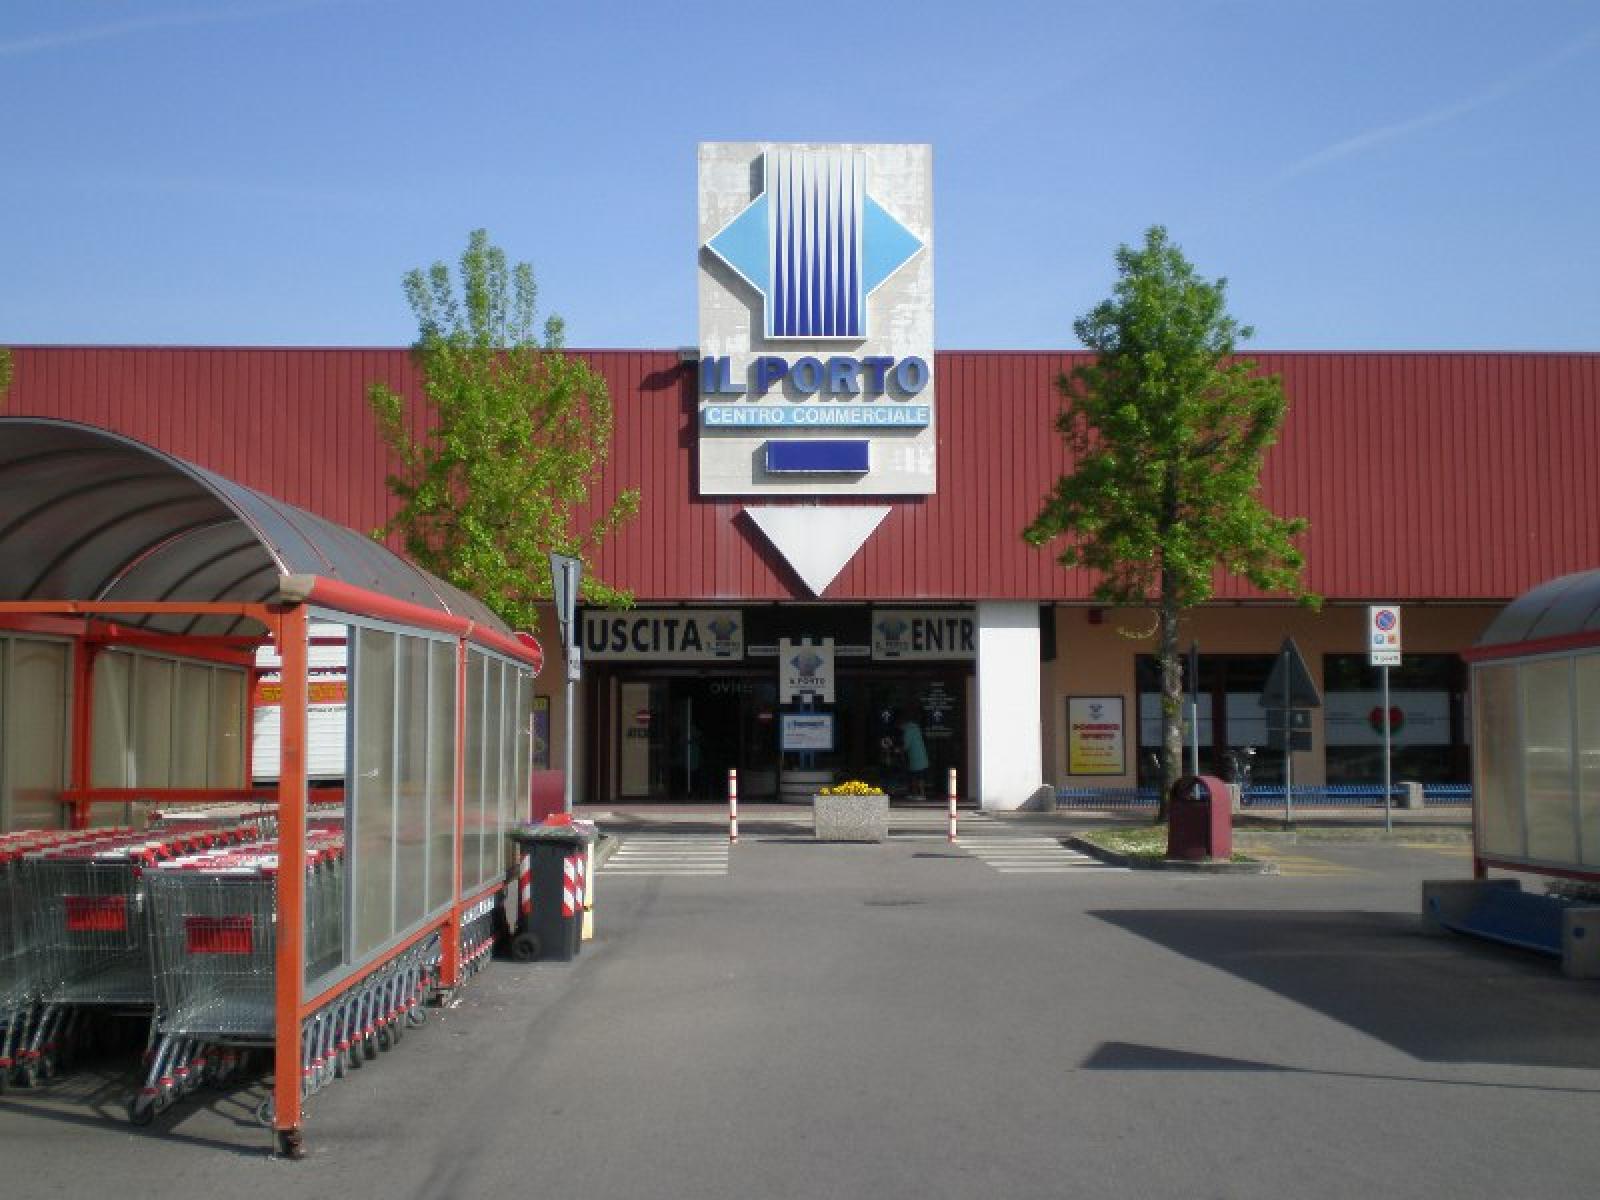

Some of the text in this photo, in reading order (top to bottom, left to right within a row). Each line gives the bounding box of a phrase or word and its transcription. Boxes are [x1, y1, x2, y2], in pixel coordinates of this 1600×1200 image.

[702, 355, 930, 395] IL PORTO
[707, 407, 928, 424] CENTRO COMMERCIALE
[587, 619, 703, 652] USCITA
[912, 618, 975, 651] ENTR
